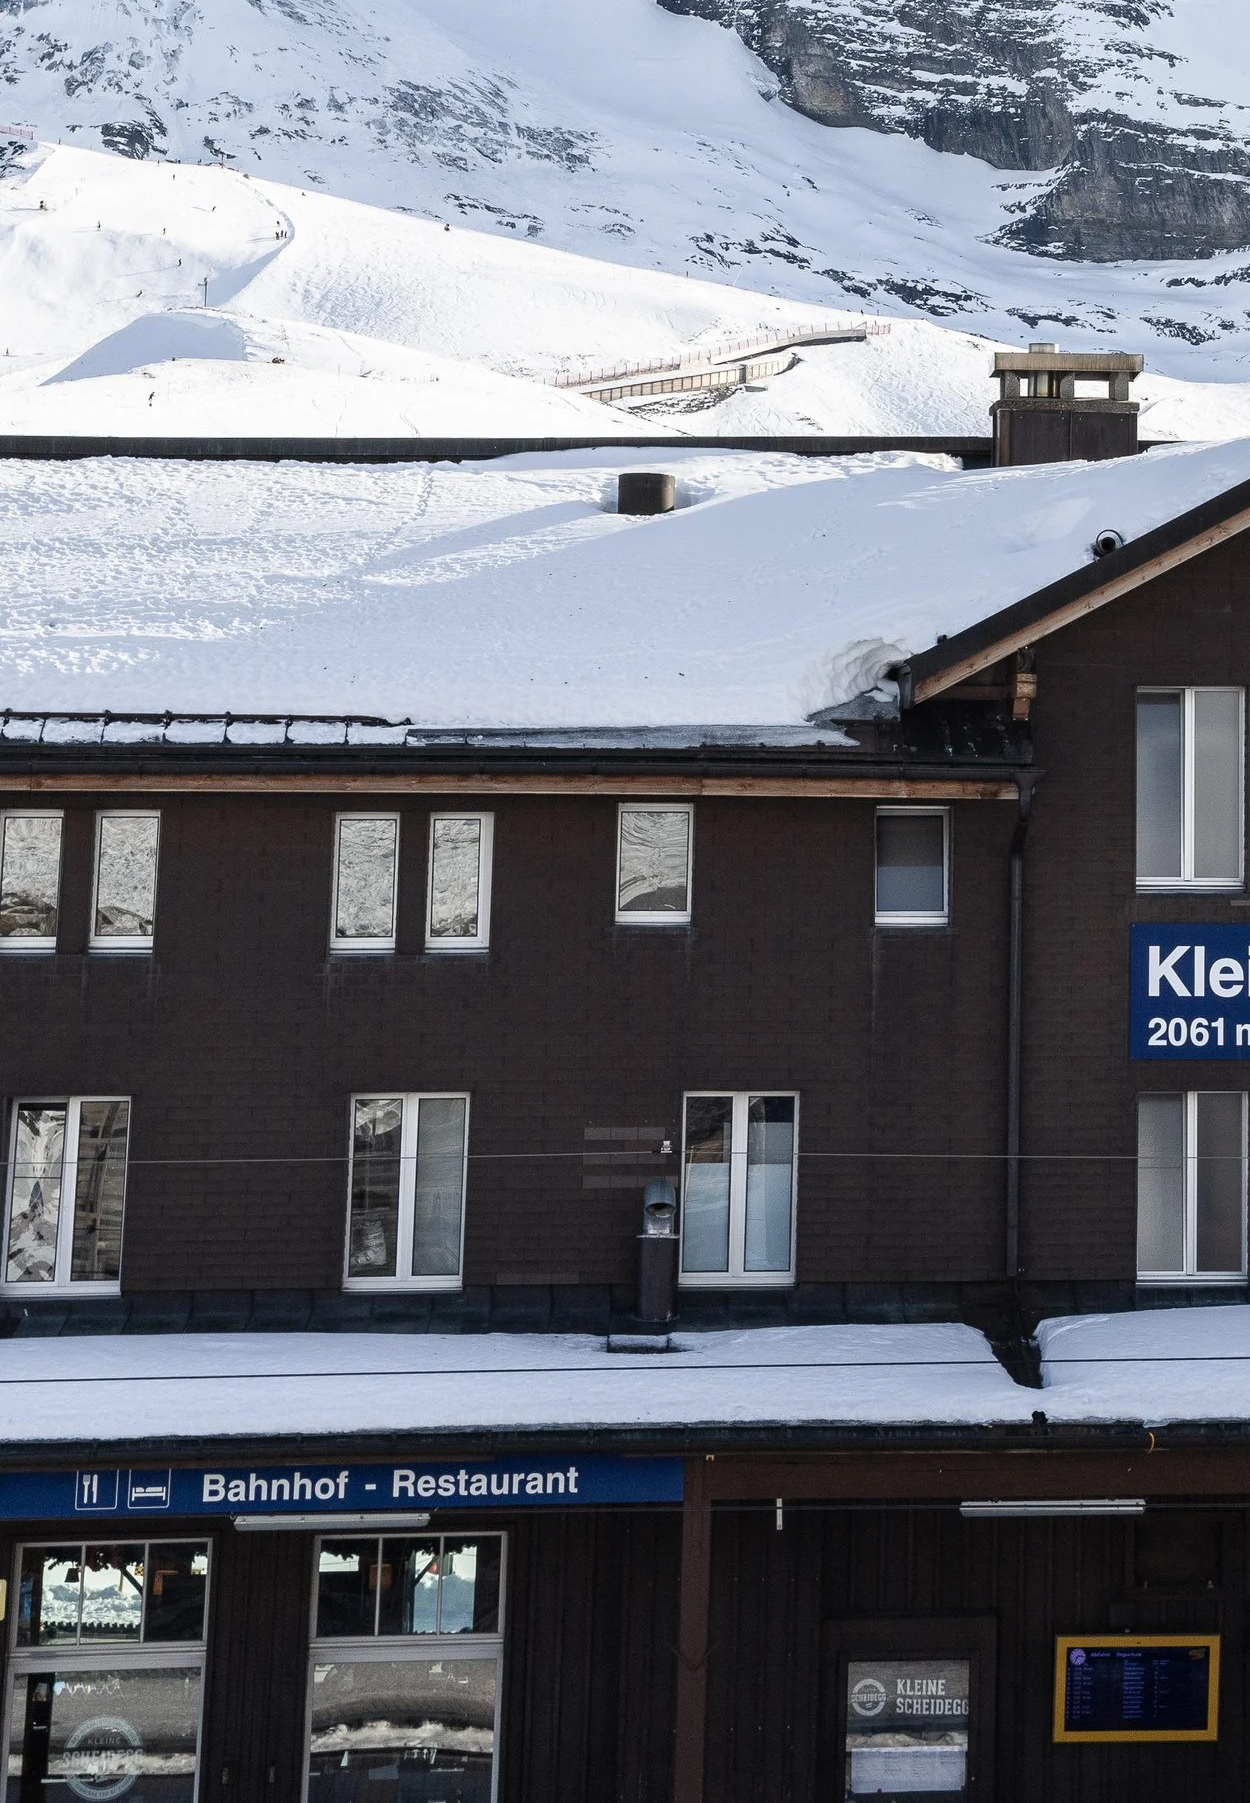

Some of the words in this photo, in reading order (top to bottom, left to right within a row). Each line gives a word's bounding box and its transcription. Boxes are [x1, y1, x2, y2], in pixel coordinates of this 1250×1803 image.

[1147, 1017, 1224, 1047] 2061
[202, 1470, 348, 1503] Bahnhof
[392, 1466, 579, 1498] Restaurant
[896, 1678, 946, 1696] KLEINE
[896, 1698, 969, 1716] SCHEIDEGG
[87, 1735, 121, 1745] KLEINE
